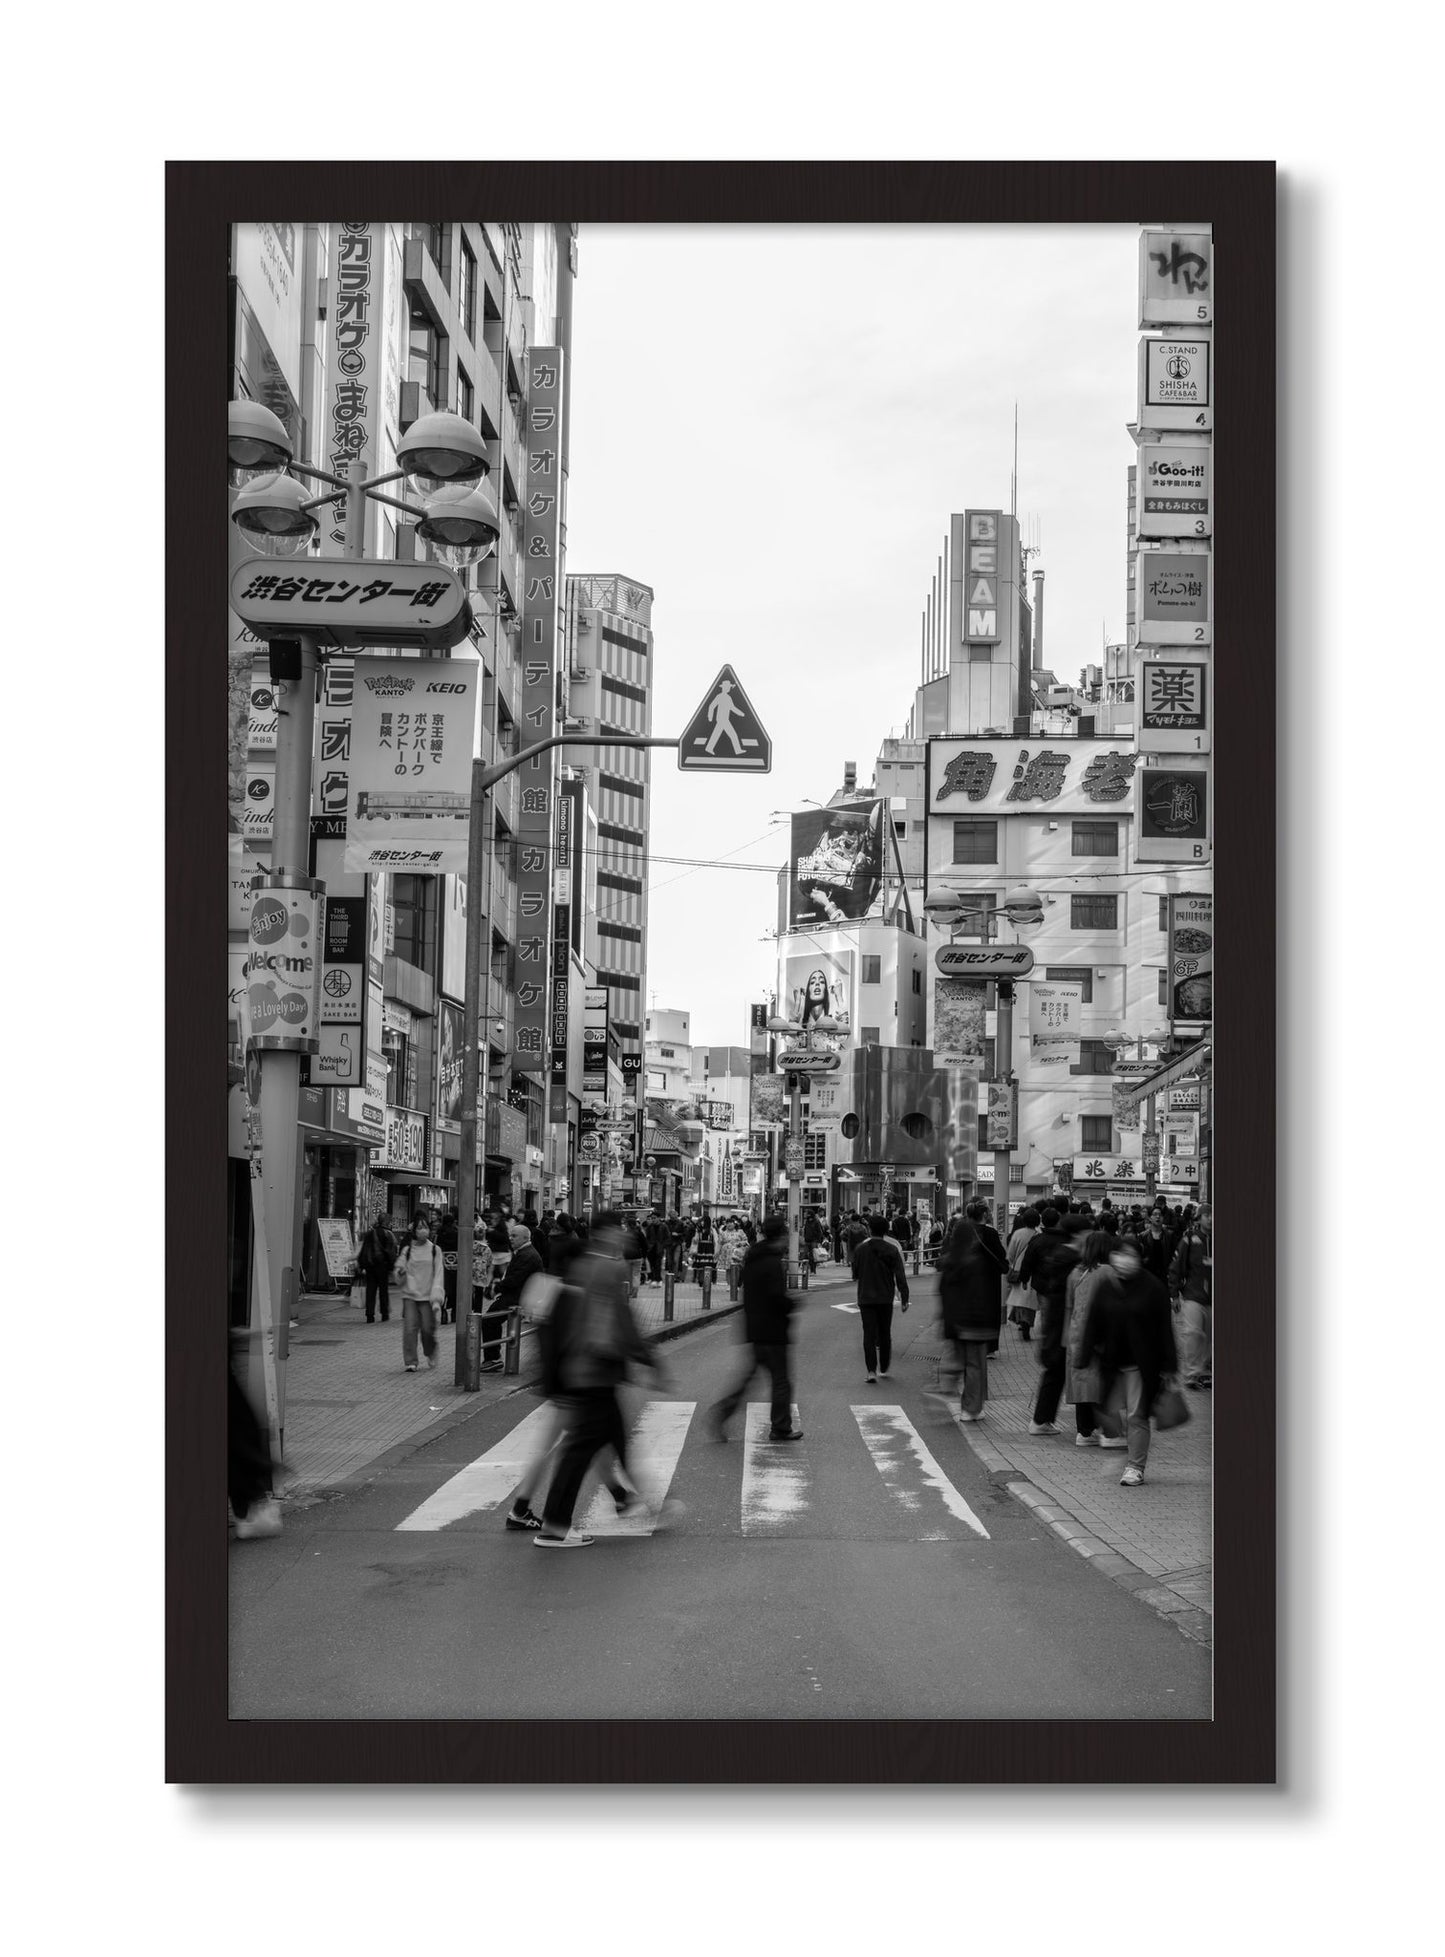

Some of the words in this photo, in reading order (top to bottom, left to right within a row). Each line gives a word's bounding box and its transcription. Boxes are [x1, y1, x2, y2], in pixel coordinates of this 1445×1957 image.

[336, 235, 373, 352] カラオケ
[1197, 306, 1207, 319] 5
[1159, 346, 1198, 354] C.STAND
[1160, 381, 1197, 389] SHISHA
[1158, 463, 1204, 476] Goo-it!
[1148, 501, 1205, 511] 全身もみほぐし
[1195, 520, 1205, 534] 3
[969, 515, 997, 636] BEAM
[241, 575, 451, 607] 渋谷センター街
[1194, 627, 1204, 640] 2
[426, 683, 467, 694] KEIO
[1152, 669, 1194, 711] 薬
[379, 713, 393, 749] 冒険へ
[394, 713, 410, 775] カントーの
[430, 713, 445, 764] 京王線で
[1194, 736, 1201, 749] 1
[936, 750, 1139, 801] 角海老
[368, 850, 443, 861] 渋谷センター街
[1193, 845, 1203, 858] B
[252, 909, 286, 938] Enjoy
[248, 951, 313, 972] Welcome
[941, 953, 1028, 963] 渋谷センター街
[1174, 960, 1198, 977] 6F
[262, 1000, 288, 1017] Lovely
[289, 1001, 306, 1012] Day!
[320, 1056, 349, 1065] Whisky
[623, 1058, 641, 1068] GU
[780, 1056, 833, 1064] 渋谷センター街
[1085, 1159, 1136, 1177] 兆楽
